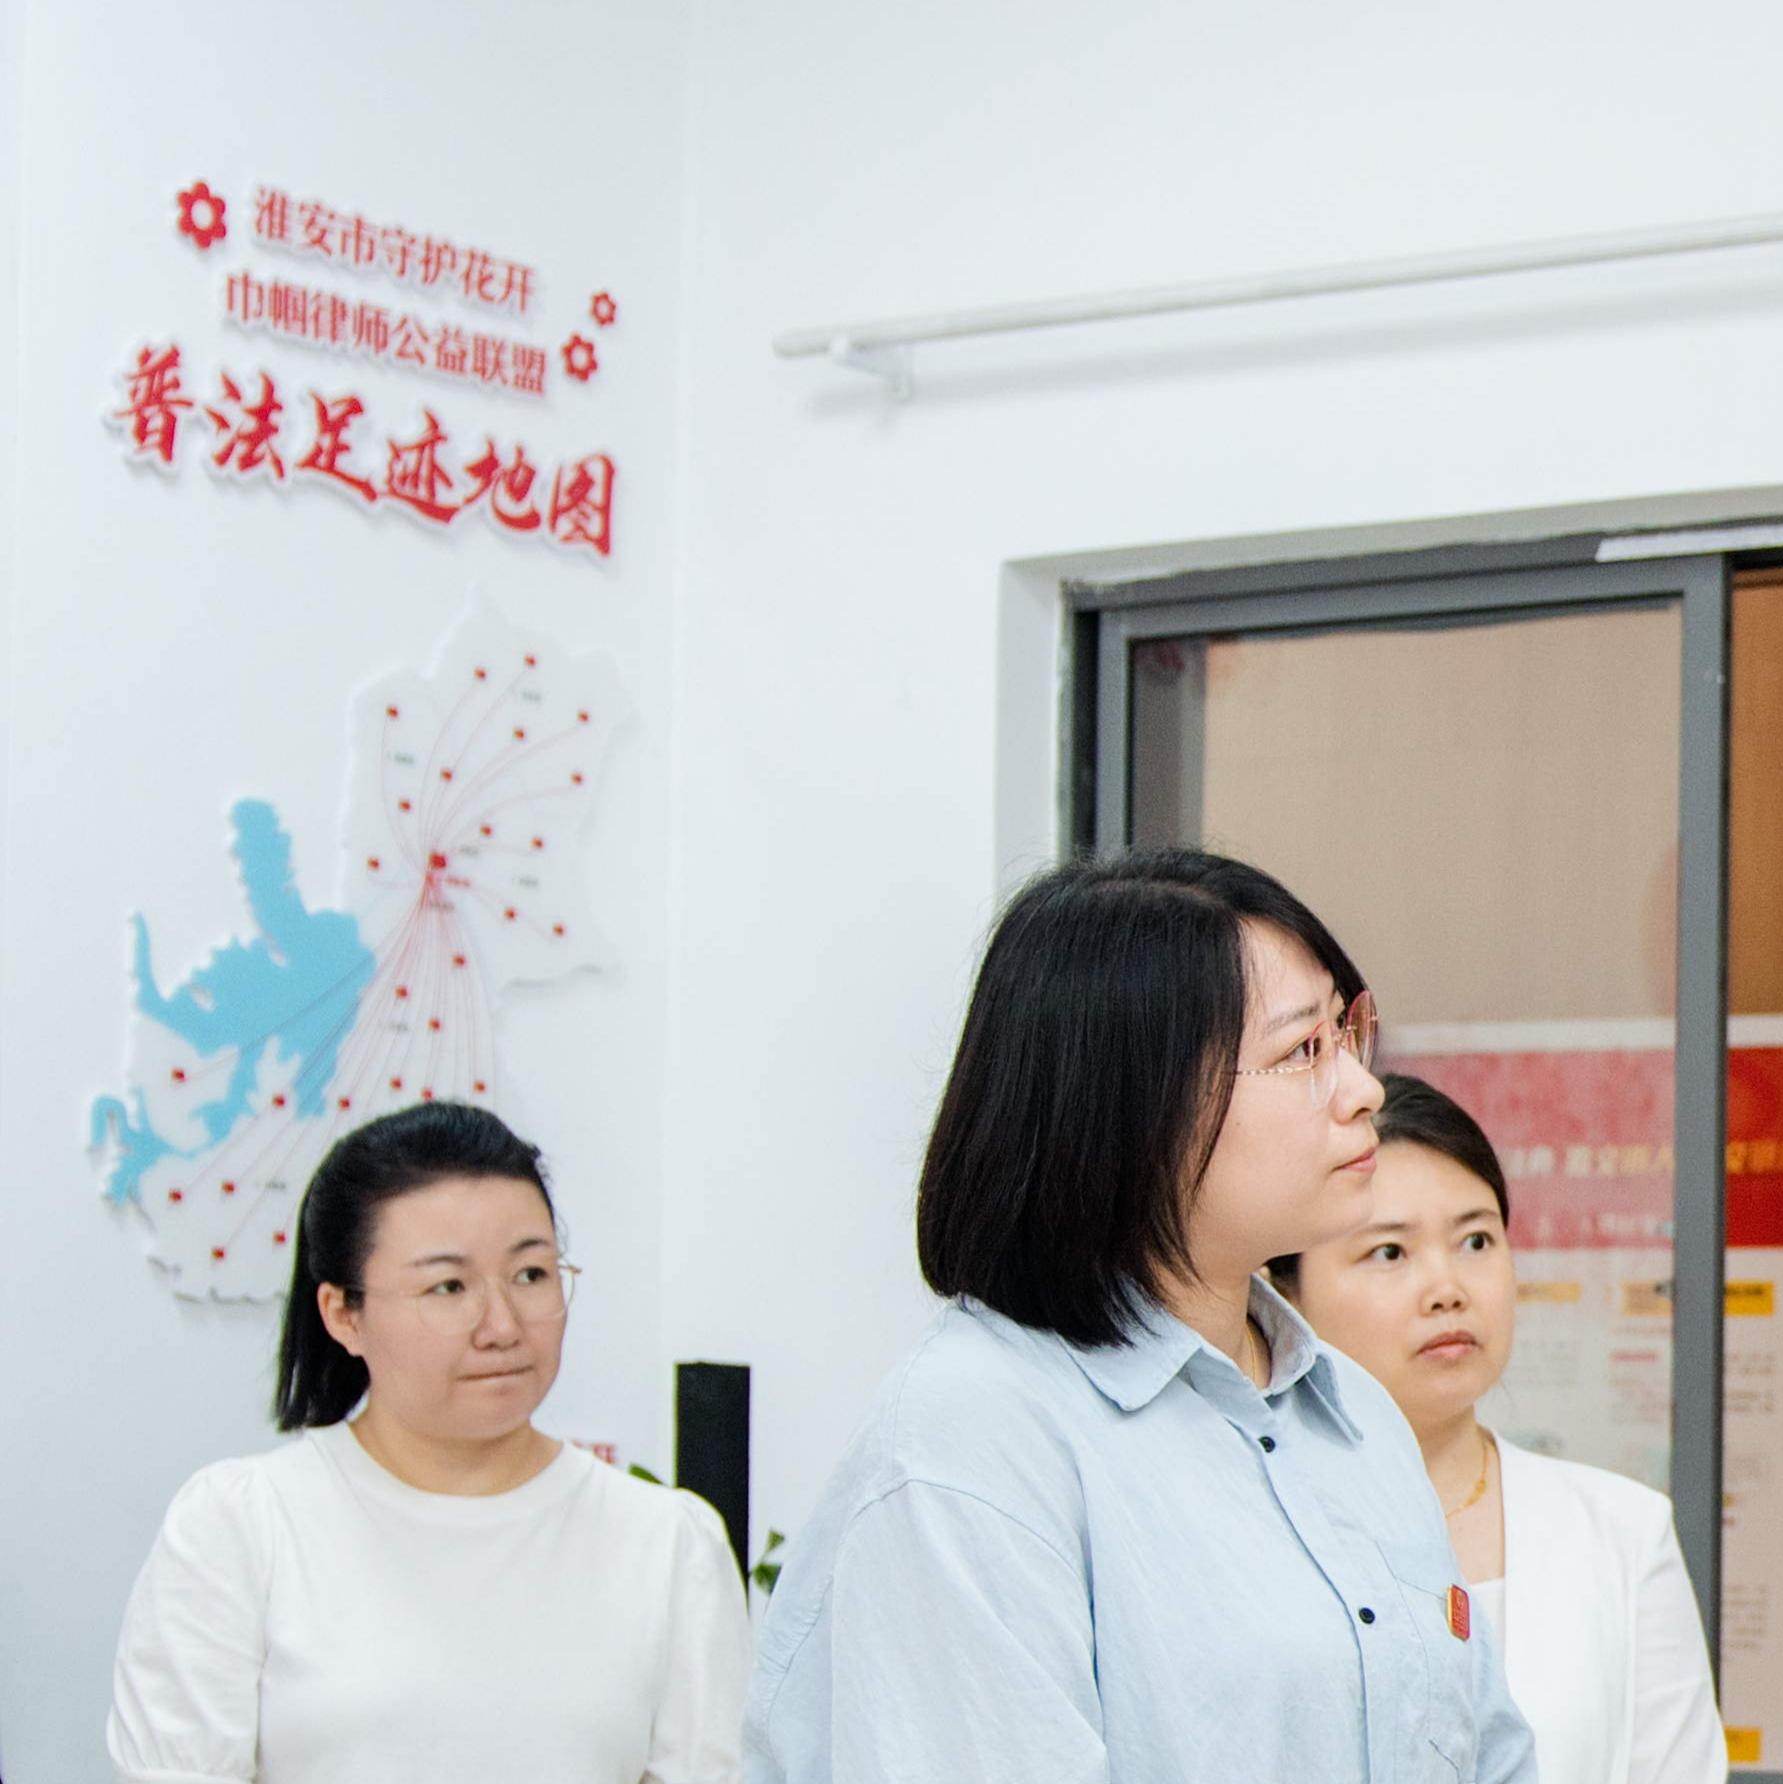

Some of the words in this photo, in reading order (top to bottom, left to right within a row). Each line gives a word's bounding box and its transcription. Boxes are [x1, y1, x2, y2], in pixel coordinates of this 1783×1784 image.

[253, 184, 536, 314] 淮安市守护花开
[225, 268, 548, 398] 巾帼律师公益联盟
[112, 342, 615, 557] 普法足迹地图
